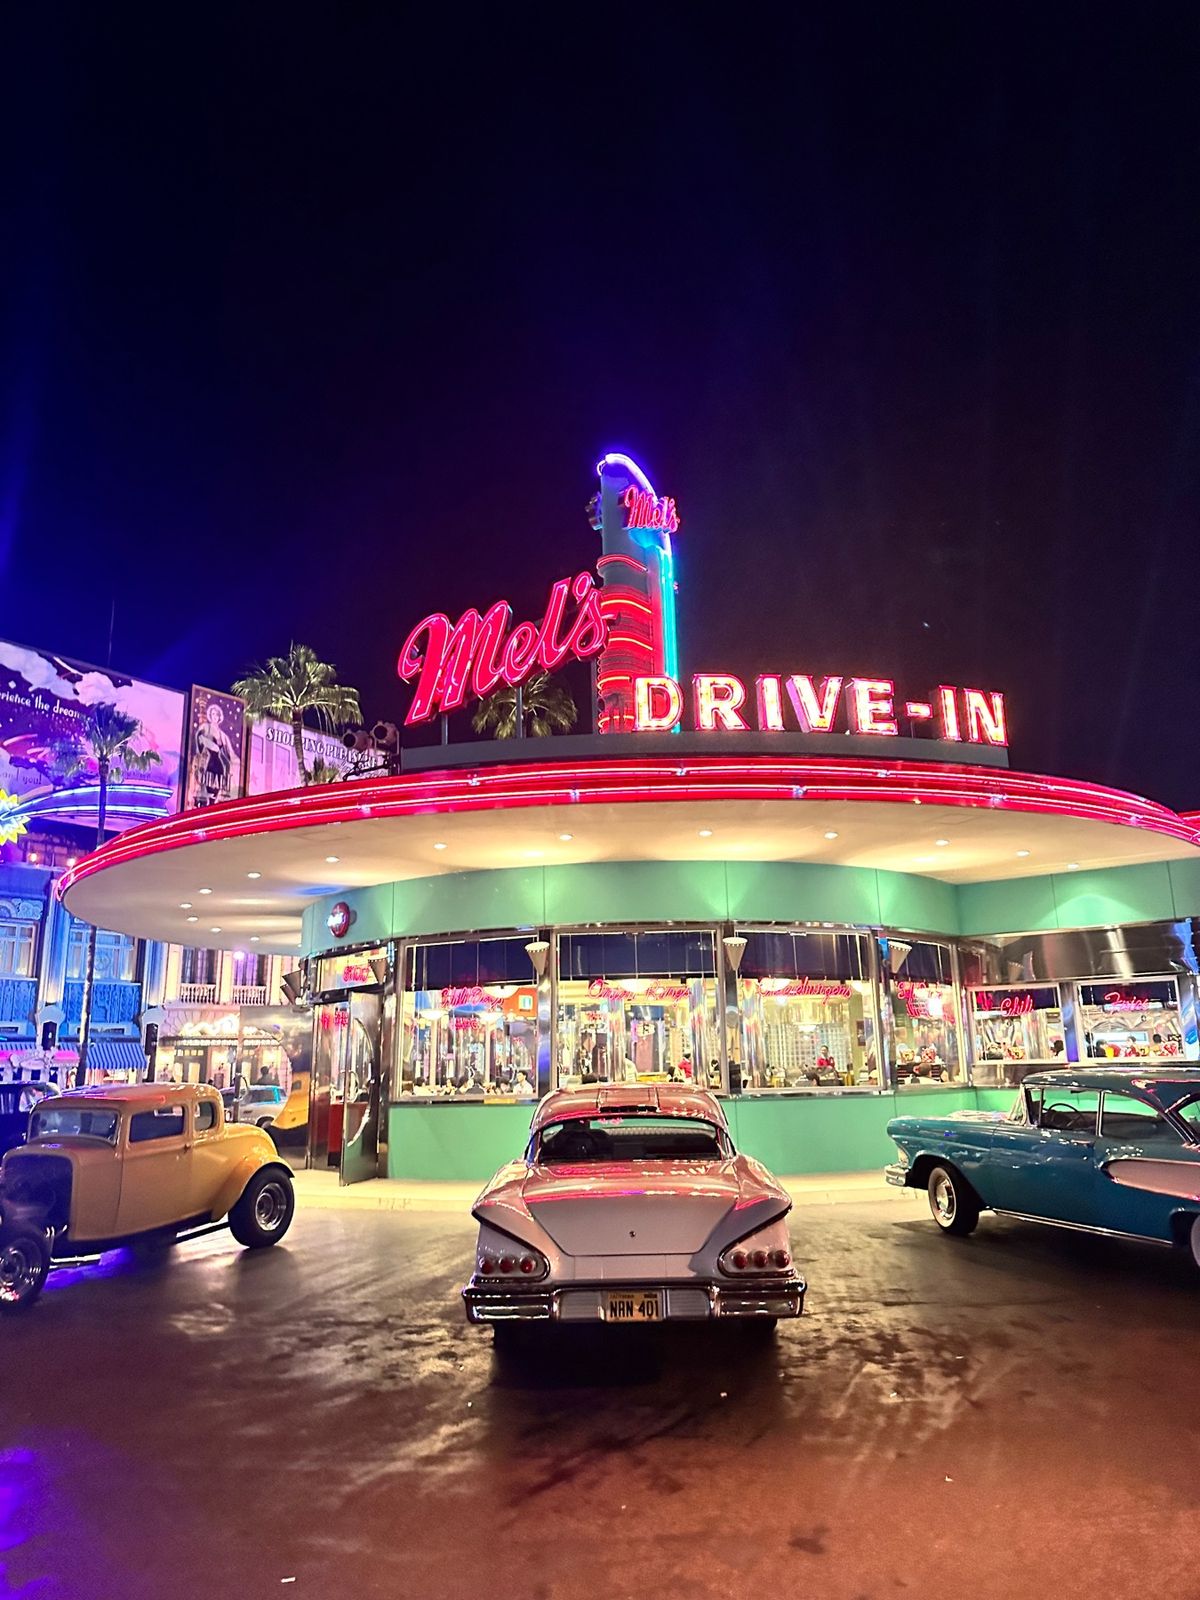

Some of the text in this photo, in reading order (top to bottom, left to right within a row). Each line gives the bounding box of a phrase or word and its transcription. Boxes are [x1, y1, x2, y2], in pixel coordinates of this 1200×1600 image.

[624, 485, 680, 532] Mel's
[398, 571, 610, 726] Mel's
[35, 695, 50, 711] the
[631, 673, 1009, 746] DRIVE-IN
[1000, 994, 1034, 1017] Chili
[1104, 992, 1149, 1015] Fries
[638, 1300, 659, 1318] 401
